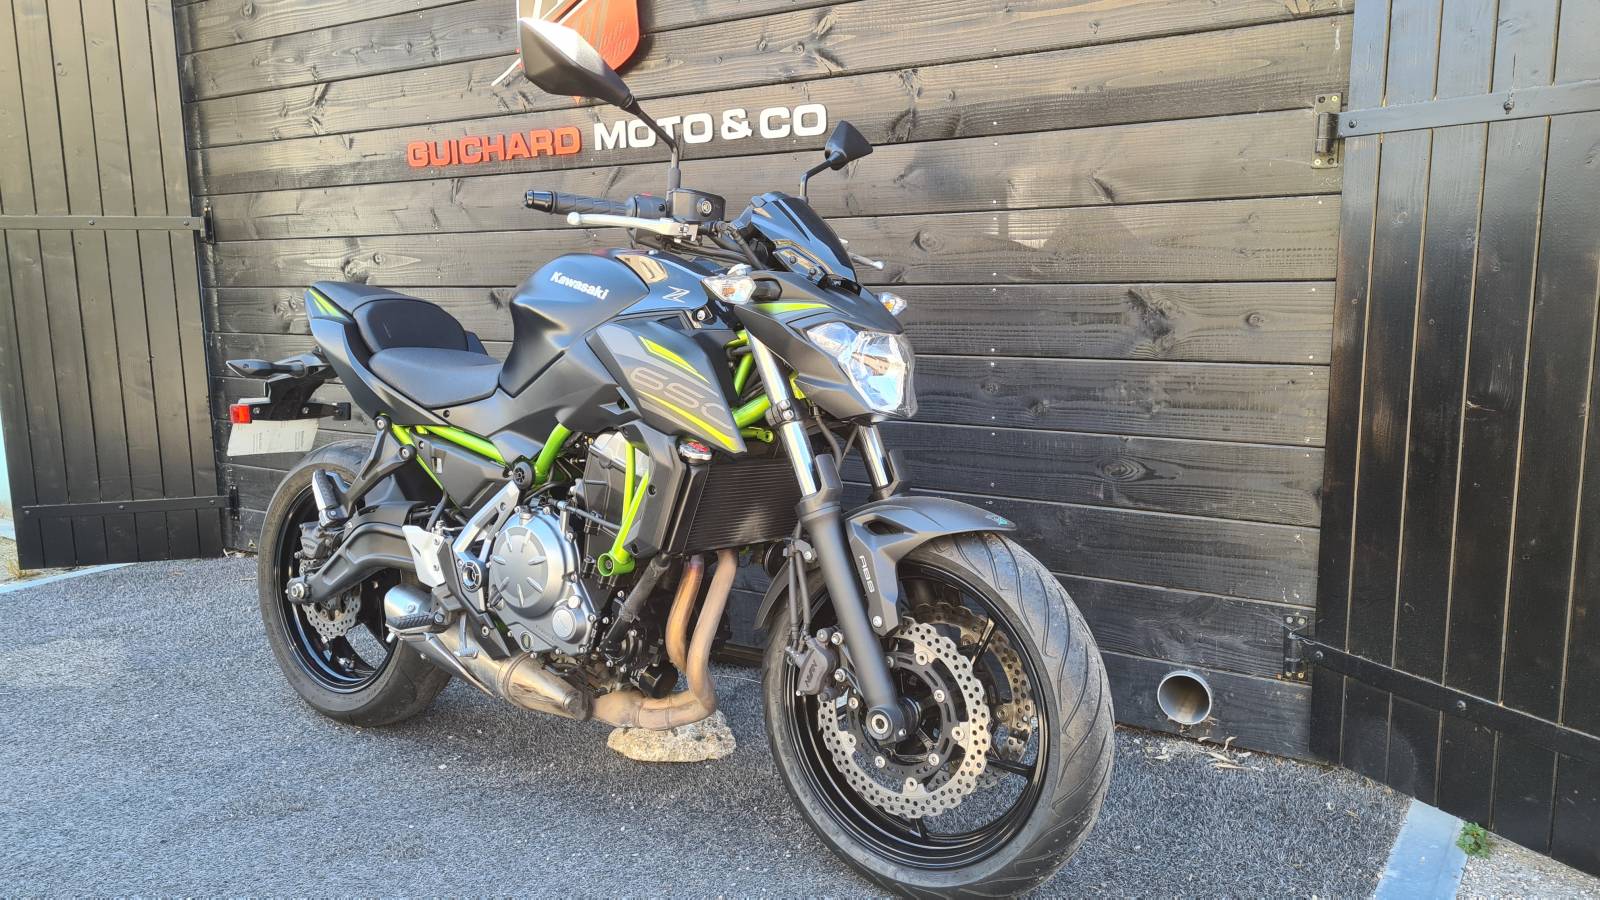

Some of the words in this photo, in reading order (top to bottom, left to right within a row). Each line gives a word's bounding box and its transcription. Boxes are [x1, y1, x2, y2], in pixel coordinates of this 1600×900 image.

[407, 126, 581, 168] GUICHARD
[550, 271, 609, 300] Kawasaki
[662, 285, 690, 303] Z
